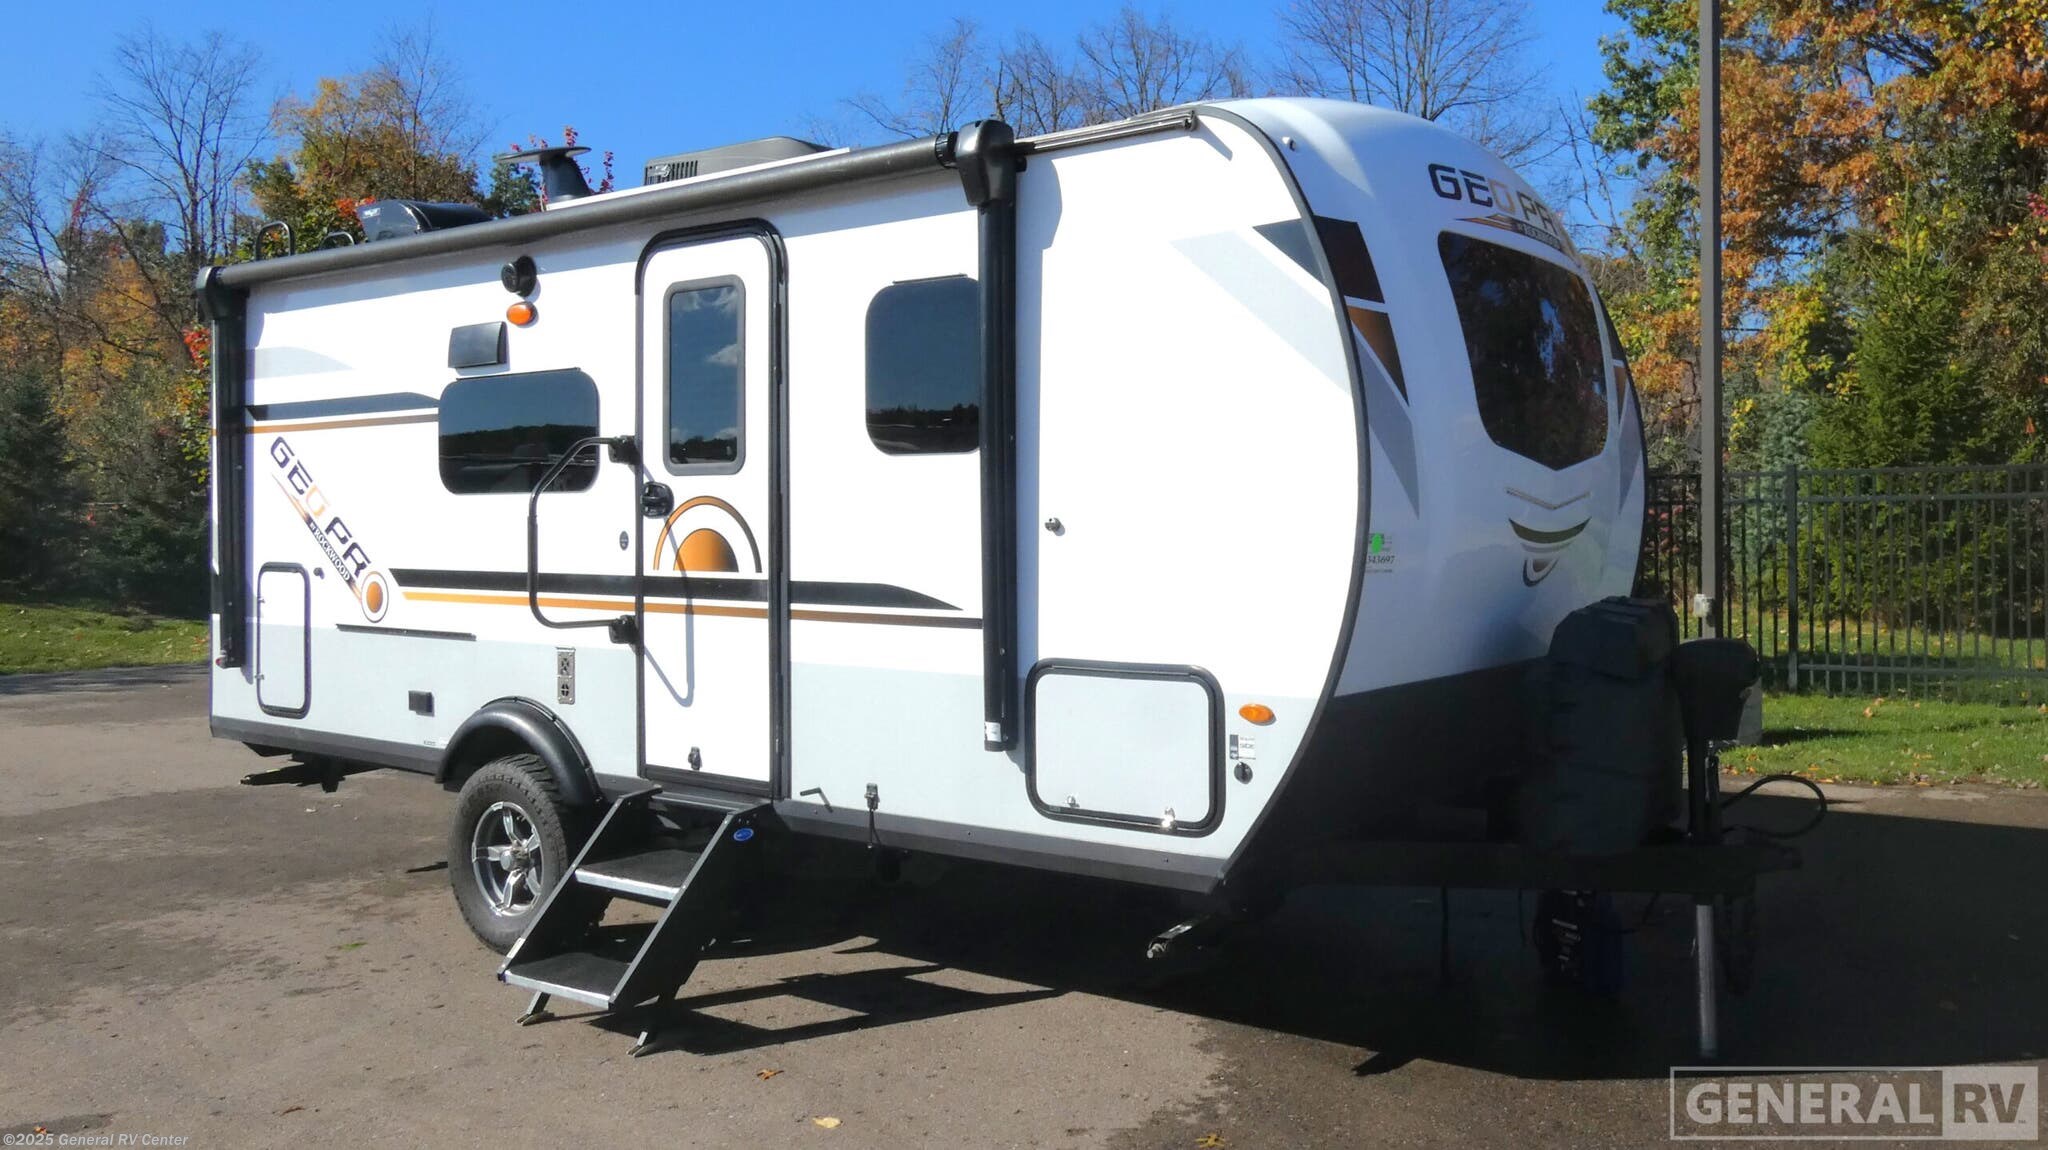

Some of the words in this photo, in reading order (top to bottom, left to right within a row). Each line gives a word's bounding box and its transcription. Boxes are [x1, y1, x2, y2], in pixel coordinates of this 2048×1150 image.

[1428, 163, 1516, 214] GEO
[1516, 190, 1560, 236] PR
[270, 436, 330, 518] GEO
[313, 527, 350, 581] ROCKWOOD
